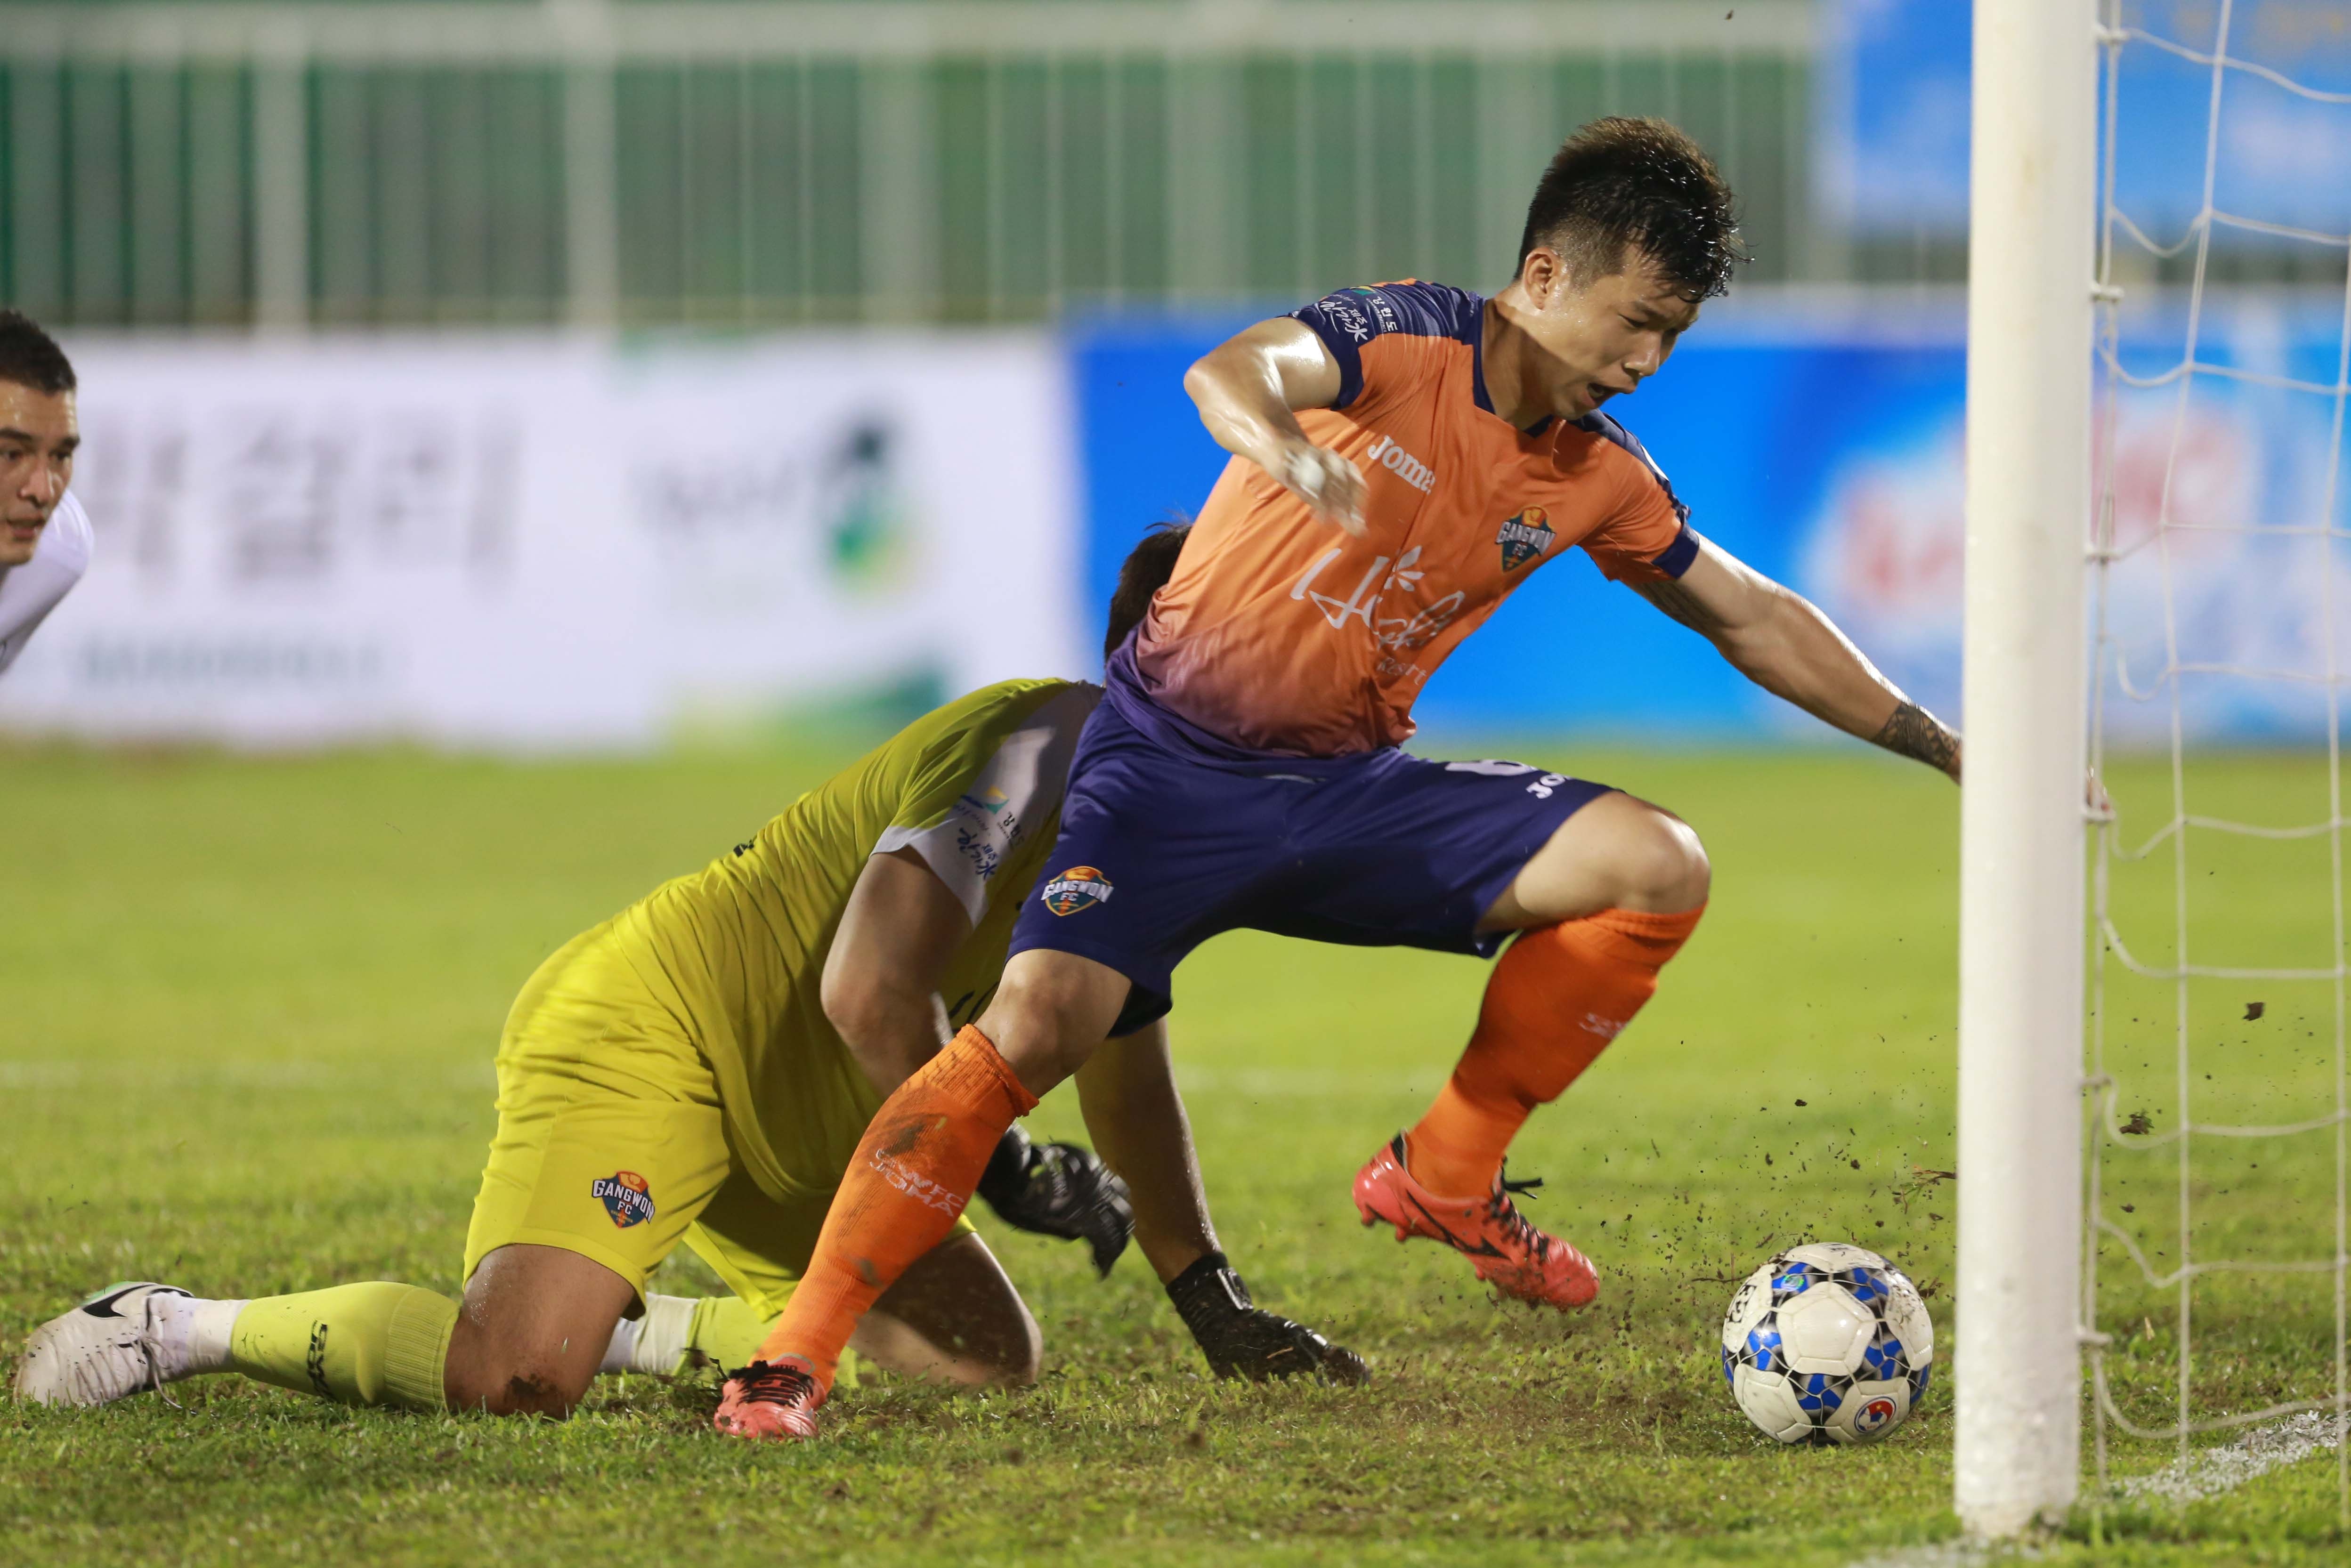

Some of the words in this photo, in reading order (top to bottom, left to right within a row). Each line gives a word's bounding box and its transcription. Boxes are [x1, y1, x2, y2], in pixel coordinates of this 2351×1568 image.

[1348, 308, 1368, 325] 제주
[1372, 296, 1398, 332] 강원도
[1367, 434, 1436, 495] Joma
[1040, 880, 1115, 903] GANGWON
[1060, 892, 1079, 901] FC
[592, 1180, 655, 1223] GANGWON
[617, 1201, 632, 1215] FC
